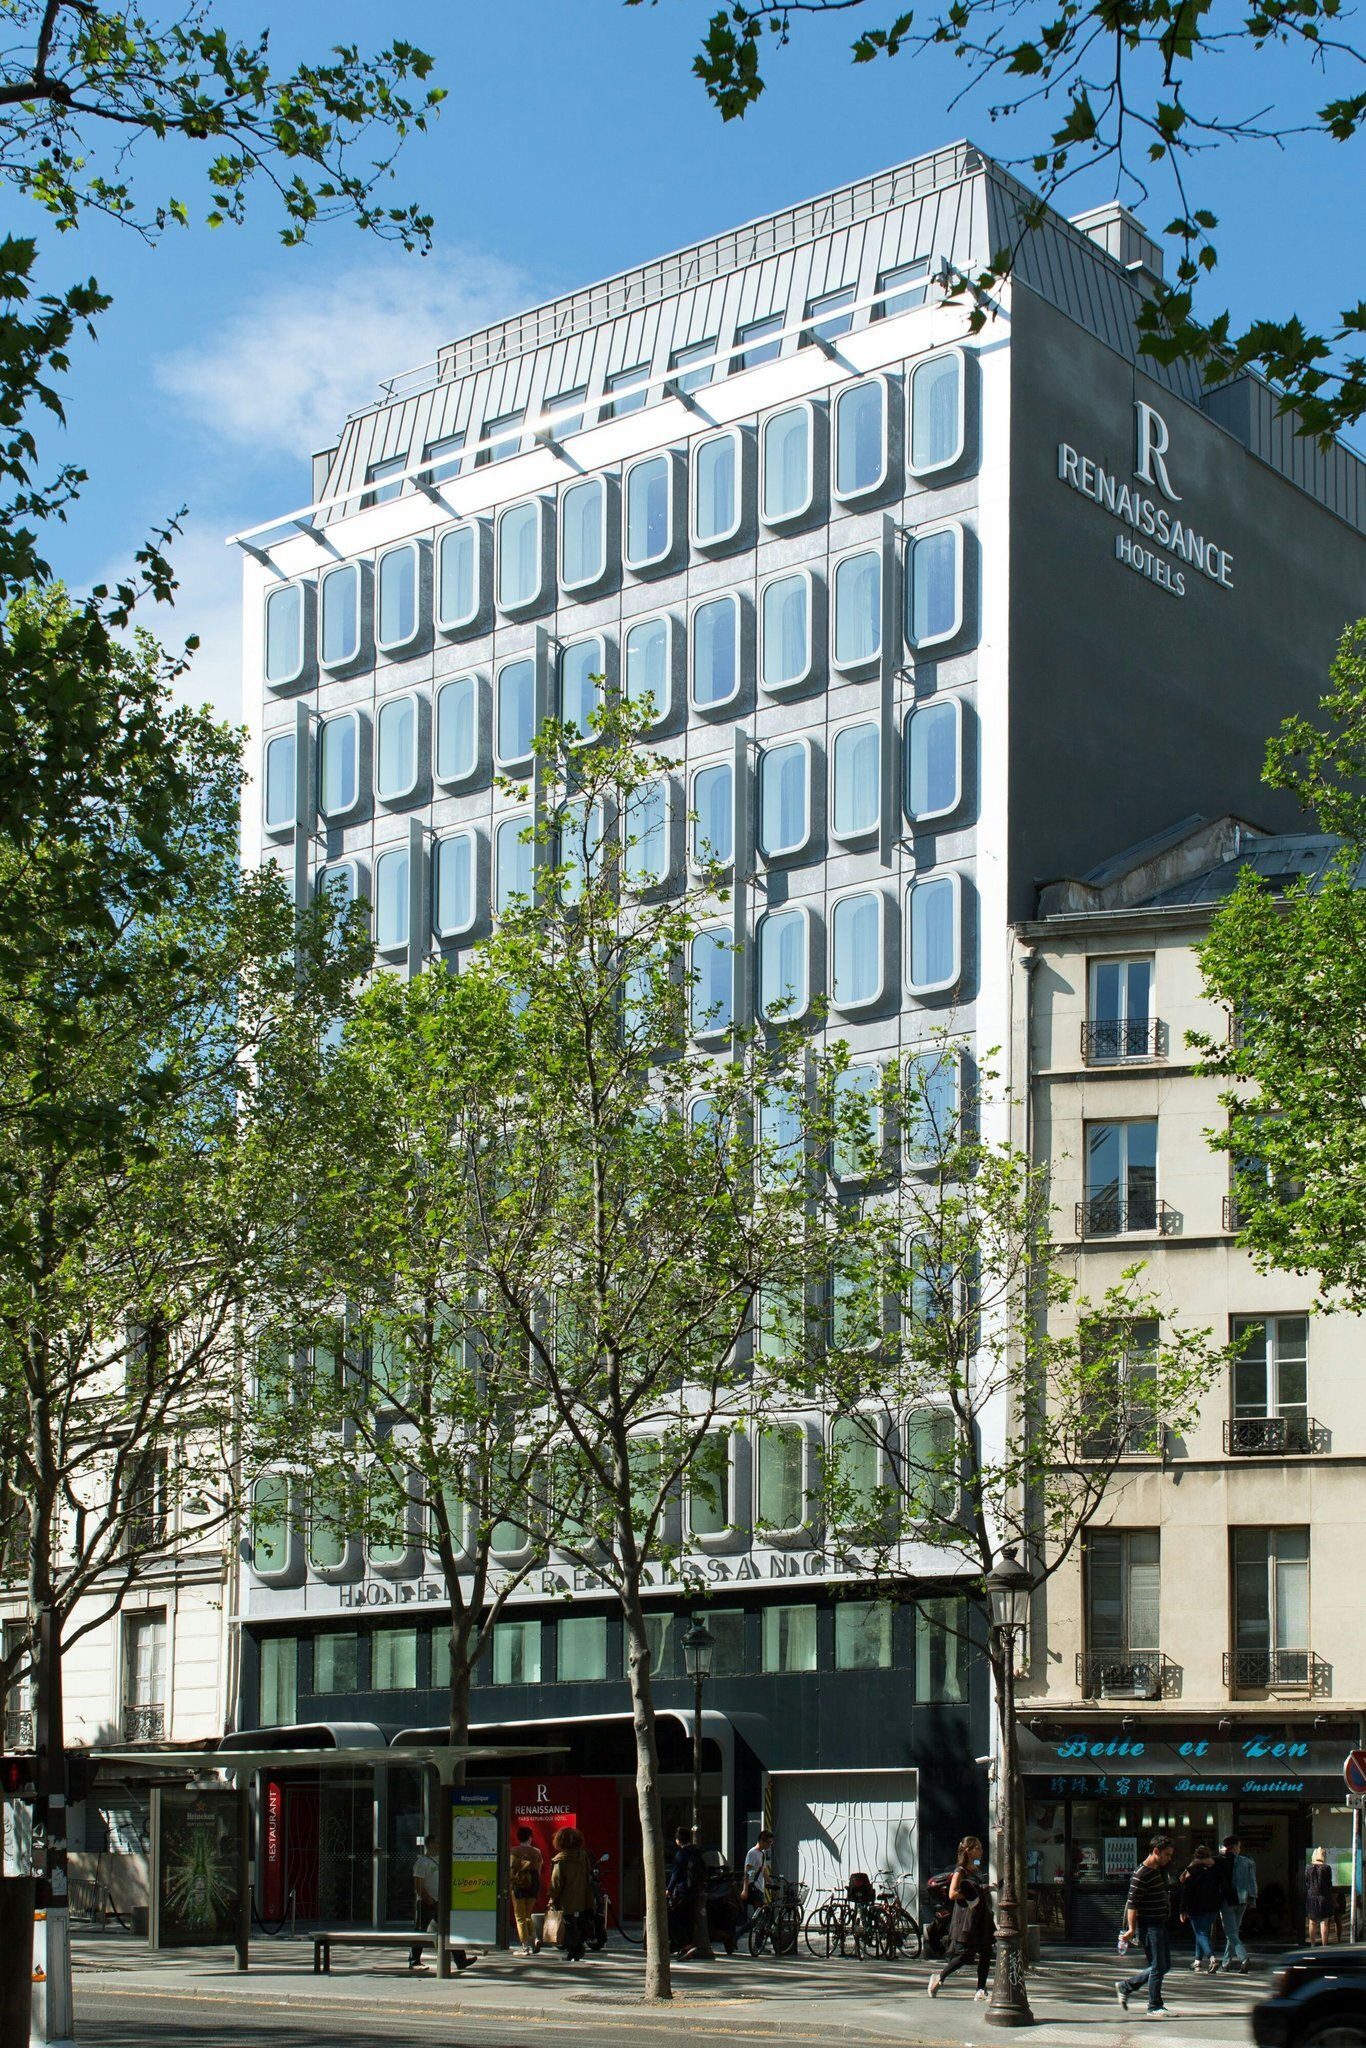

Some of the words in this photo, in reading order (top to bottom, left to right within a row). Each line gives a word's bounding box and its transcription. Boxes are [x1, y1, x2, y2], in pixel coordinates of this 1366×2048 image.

[1133, 400, 1182, 501] R
[1058, 443, 1234, 589] RENAISSANCE
[1115, 534, 1186, 598] HOTELS
[1057, 1734, 1145, 1758] Belle
[1178, 1739, 1209, 1757] et
[1242, 1733, 1308, 1758] Zen
[537, 1784, 550, 1802] R
[1174, 1779, 1229, 1792] Beaute
[1241, 1780, 1304, 1793] Institut
[268, 1790, 277, 1862] RESTAURANT
[515, 1805, 571, 1815] RENAISSANCE
